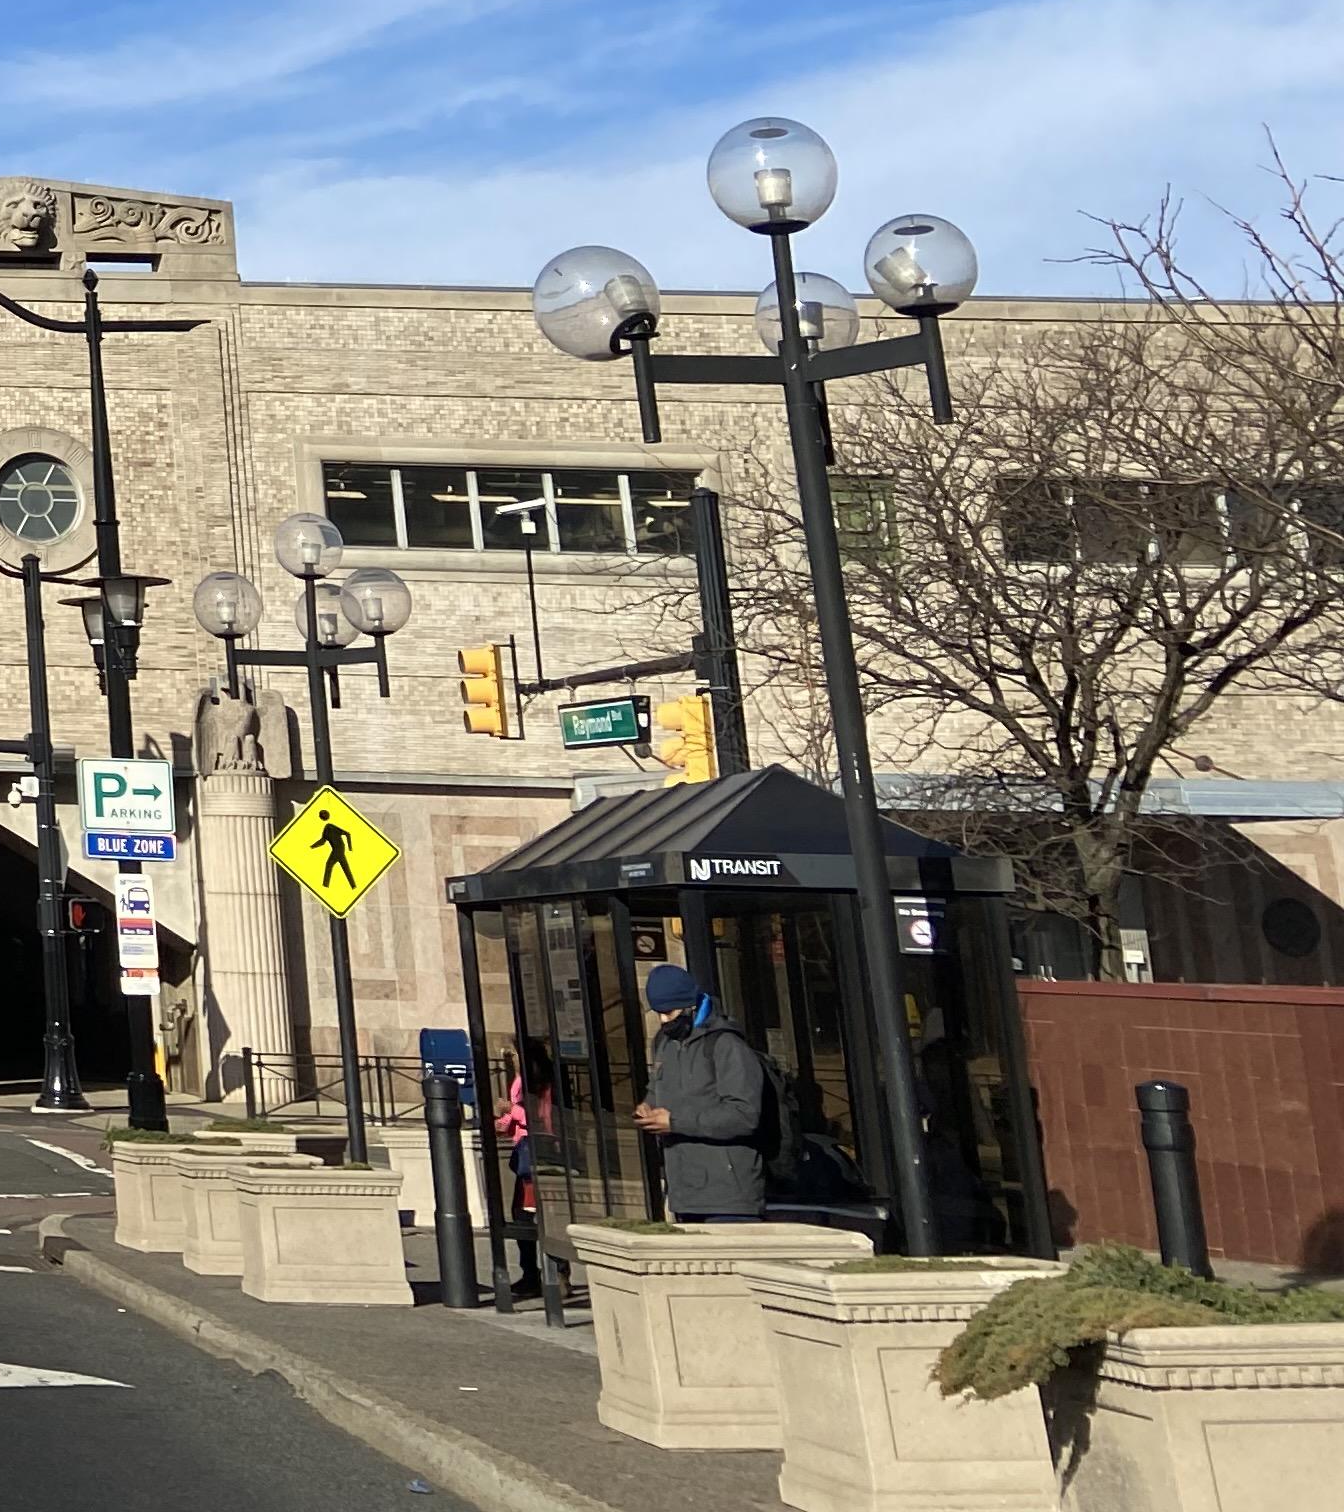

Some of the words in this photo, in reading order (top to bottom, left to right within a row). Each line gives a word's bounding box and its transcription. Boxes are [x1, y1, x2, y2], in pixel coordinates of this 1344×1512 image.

[97, 837, 129, 853] BLUE
[133, 839, 165, 855] ZONE
[711, 859, 781, 875] TRANSIT
